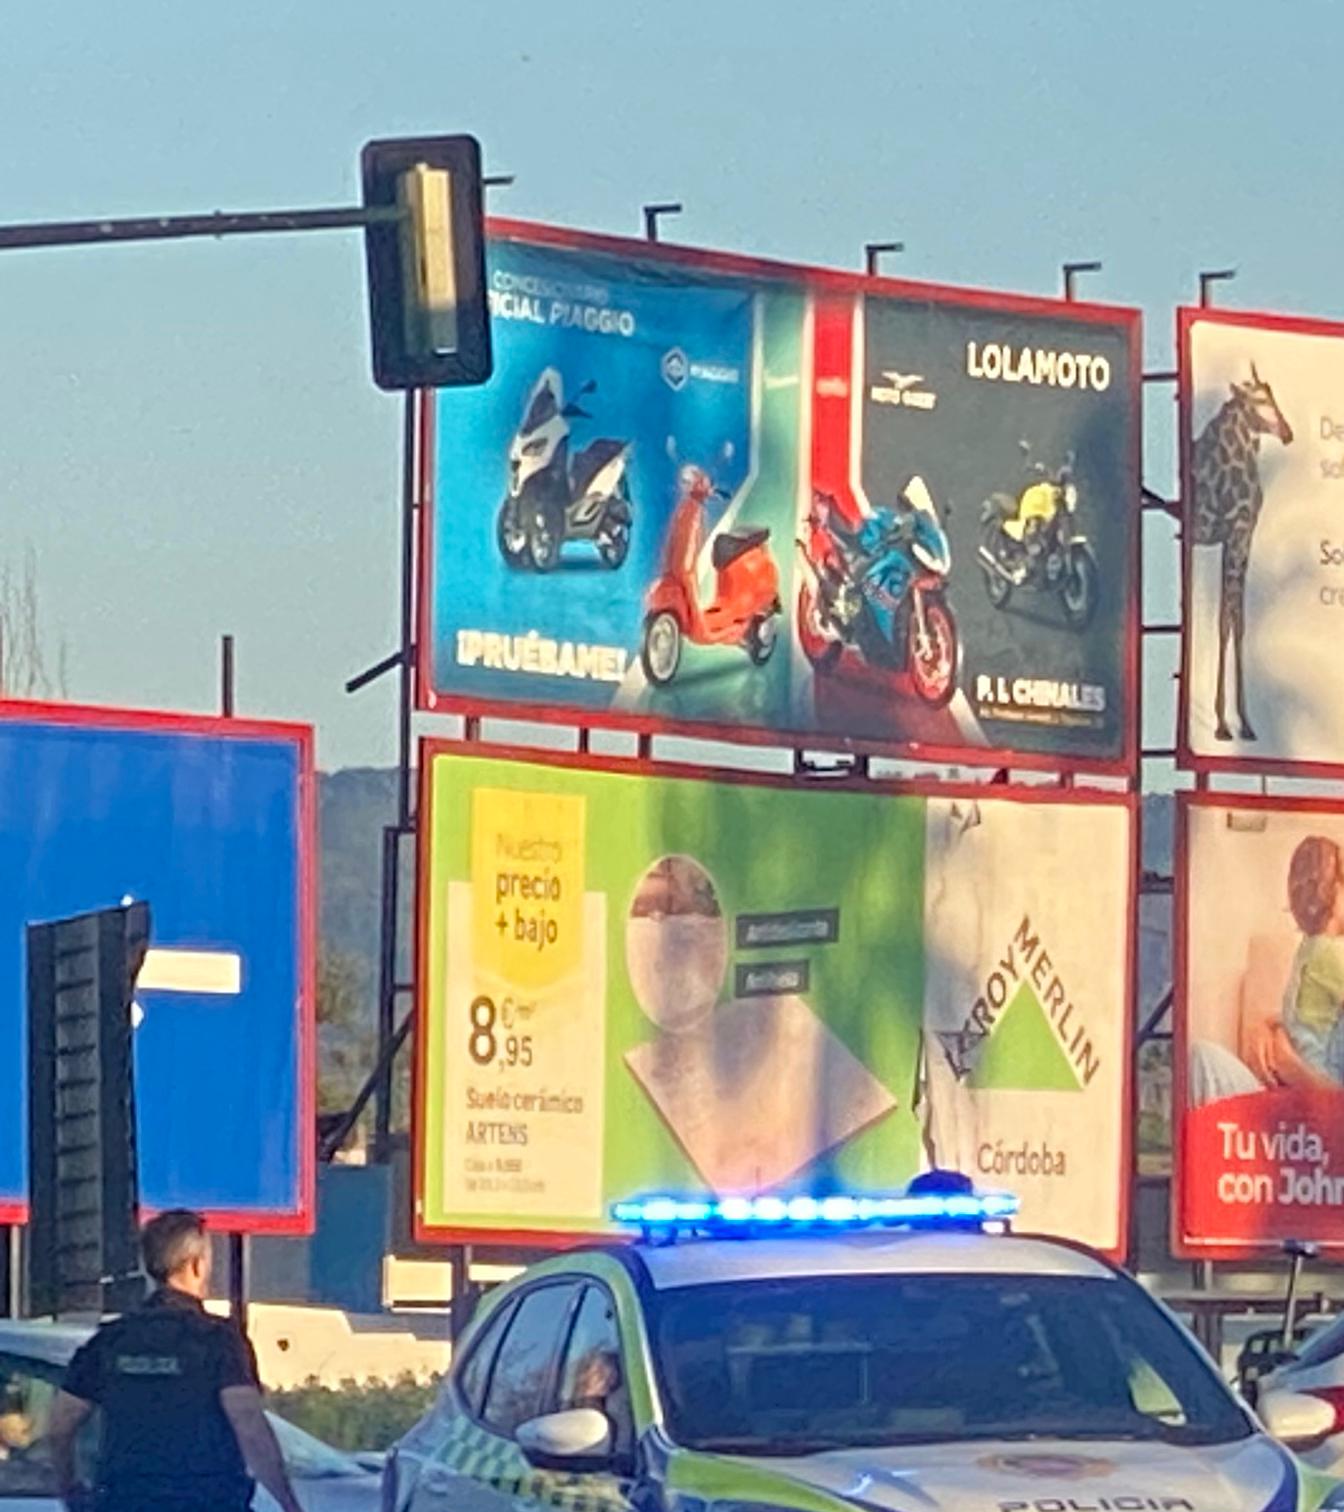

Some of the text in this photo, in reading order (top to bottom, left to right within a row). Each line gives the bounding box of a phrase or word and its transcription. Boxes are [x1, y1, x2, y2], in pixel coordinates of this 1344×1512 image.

[549, 301, 634, 337] PIAGGIO
[966, 341, 1110, 391] LOLAMOTO
[495, 867, 562, 905] precio
[514, 907, 558, 953] bajo
[1013, 914, 1101, 1087] MERLIN
[468, 995, 497, 1066] 8
[466, 1086, 510, 1110] Suelo
[977, 1140, 1066, 1176] Córdoba
[1217, 1121, 1330, 1168] Tu vida,
[1218, 1172, 1273, 1204] con
